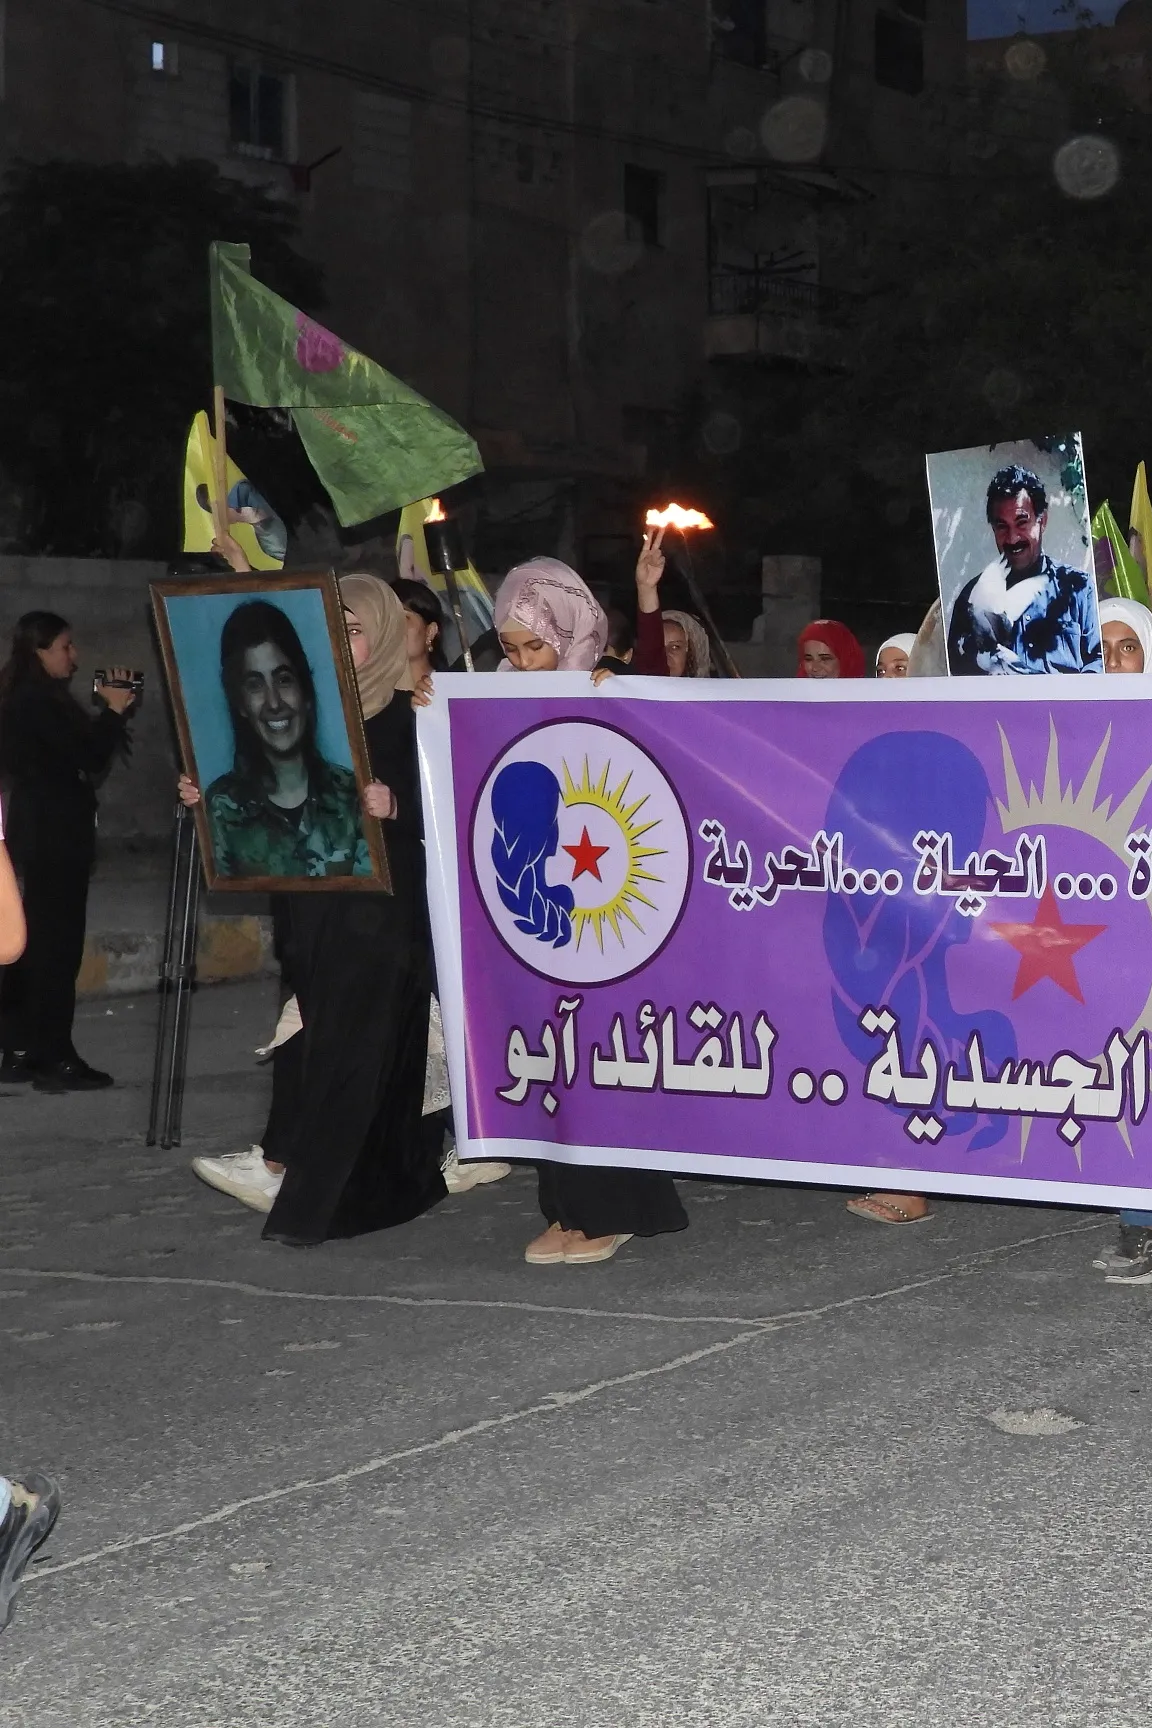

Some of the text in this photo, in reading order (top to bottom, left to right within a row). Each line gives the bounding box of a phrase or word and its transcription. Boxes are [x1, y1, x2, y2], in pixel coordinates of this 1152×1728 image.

[912, 830, 1048, 917] الحياة
[496, 994, 584, 1117] آبو
[590, 999, 779, 1100] للقائد
[863, 1004, 1150, 1147] الجسدية
